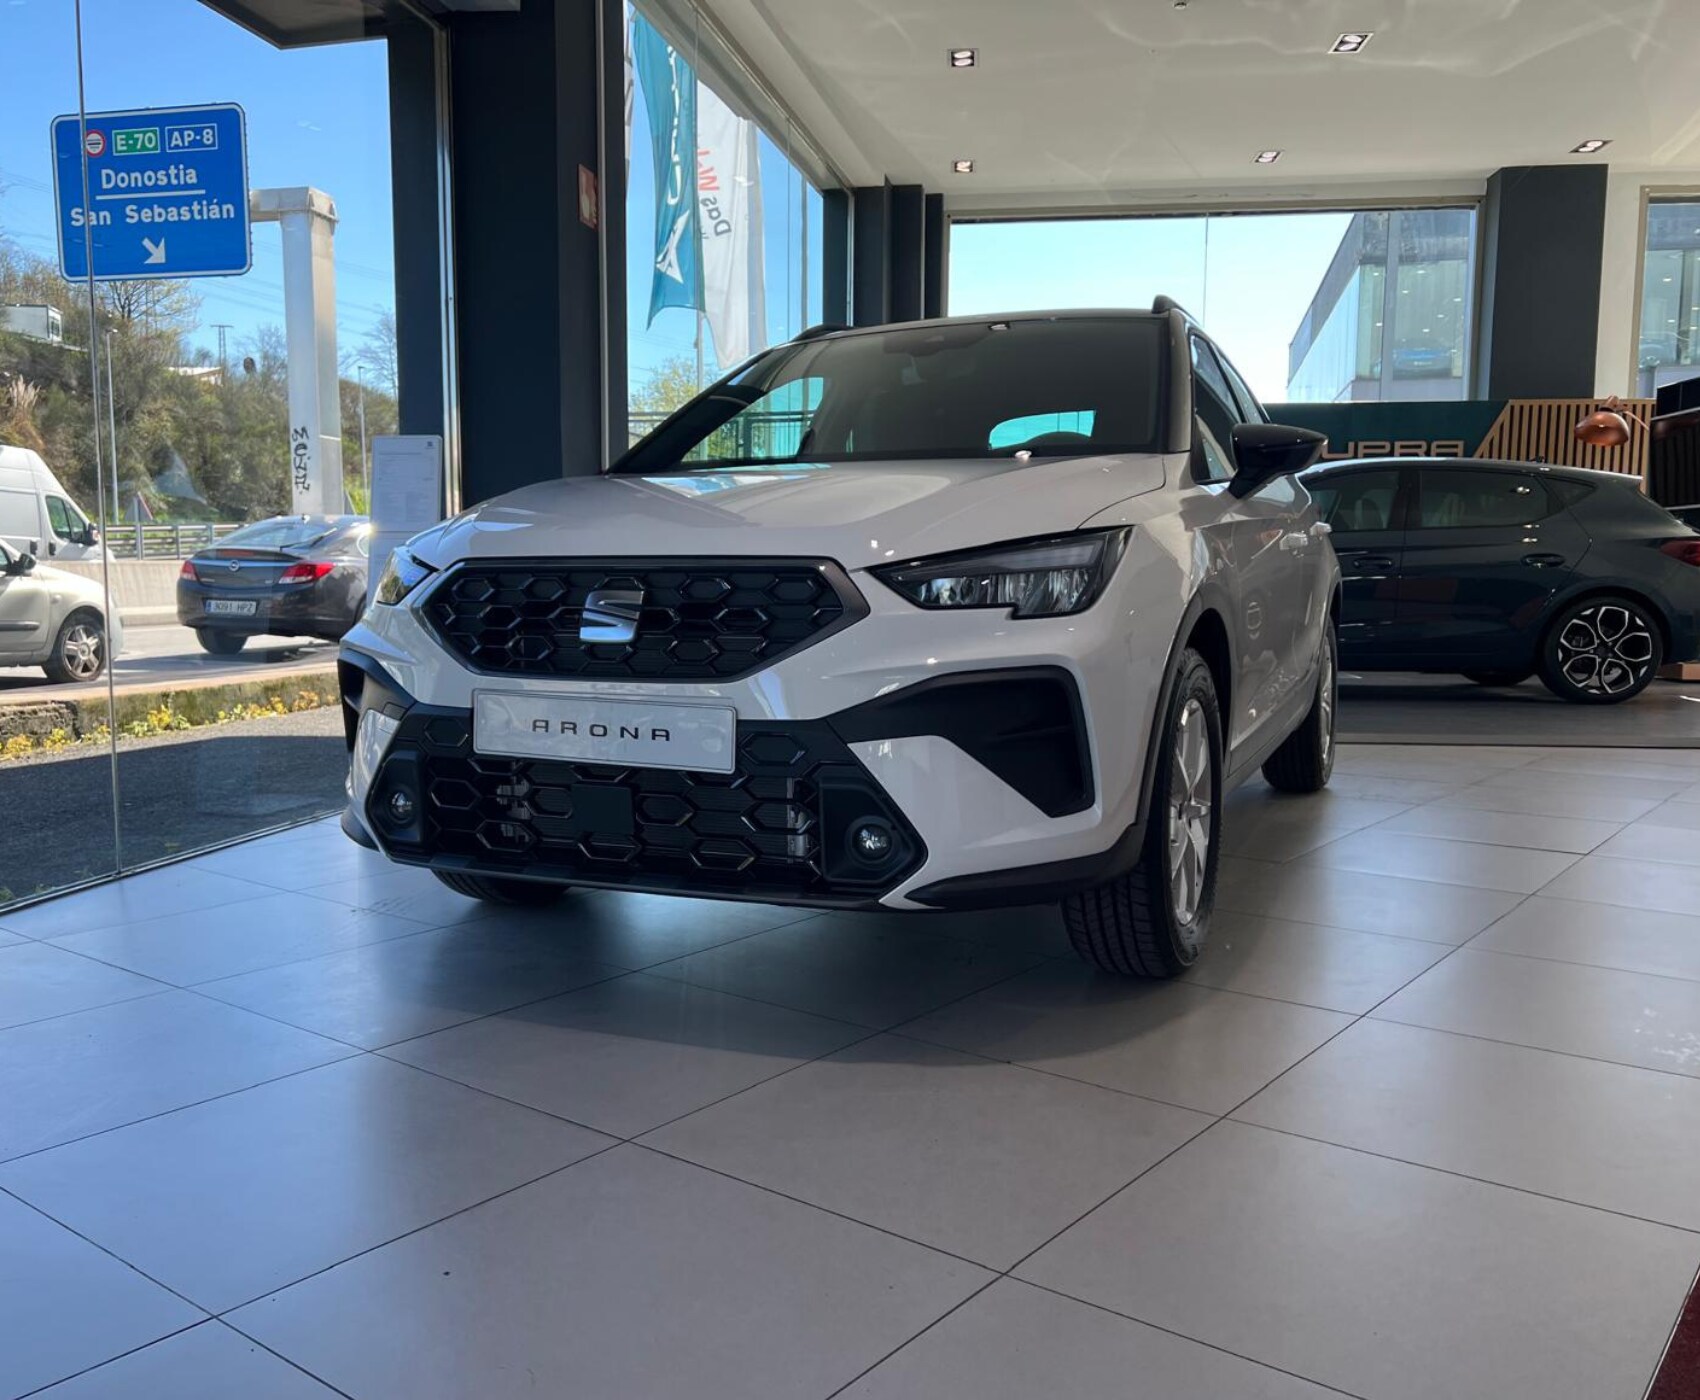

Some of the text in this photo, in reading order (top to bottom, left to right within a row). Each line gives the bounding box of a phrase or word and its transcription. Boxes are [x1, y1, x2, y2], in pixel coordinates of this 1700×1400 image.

[116, 132, 157, 151] E-70
[170, 128, 214, 148] AP-8
[101, 164, 198, 189] Donostia
[70, 199, 235, 227] San Sebastián
[1321, 440, 1464, 459] UPRA
[532, 718, 671, 742] ARONA
